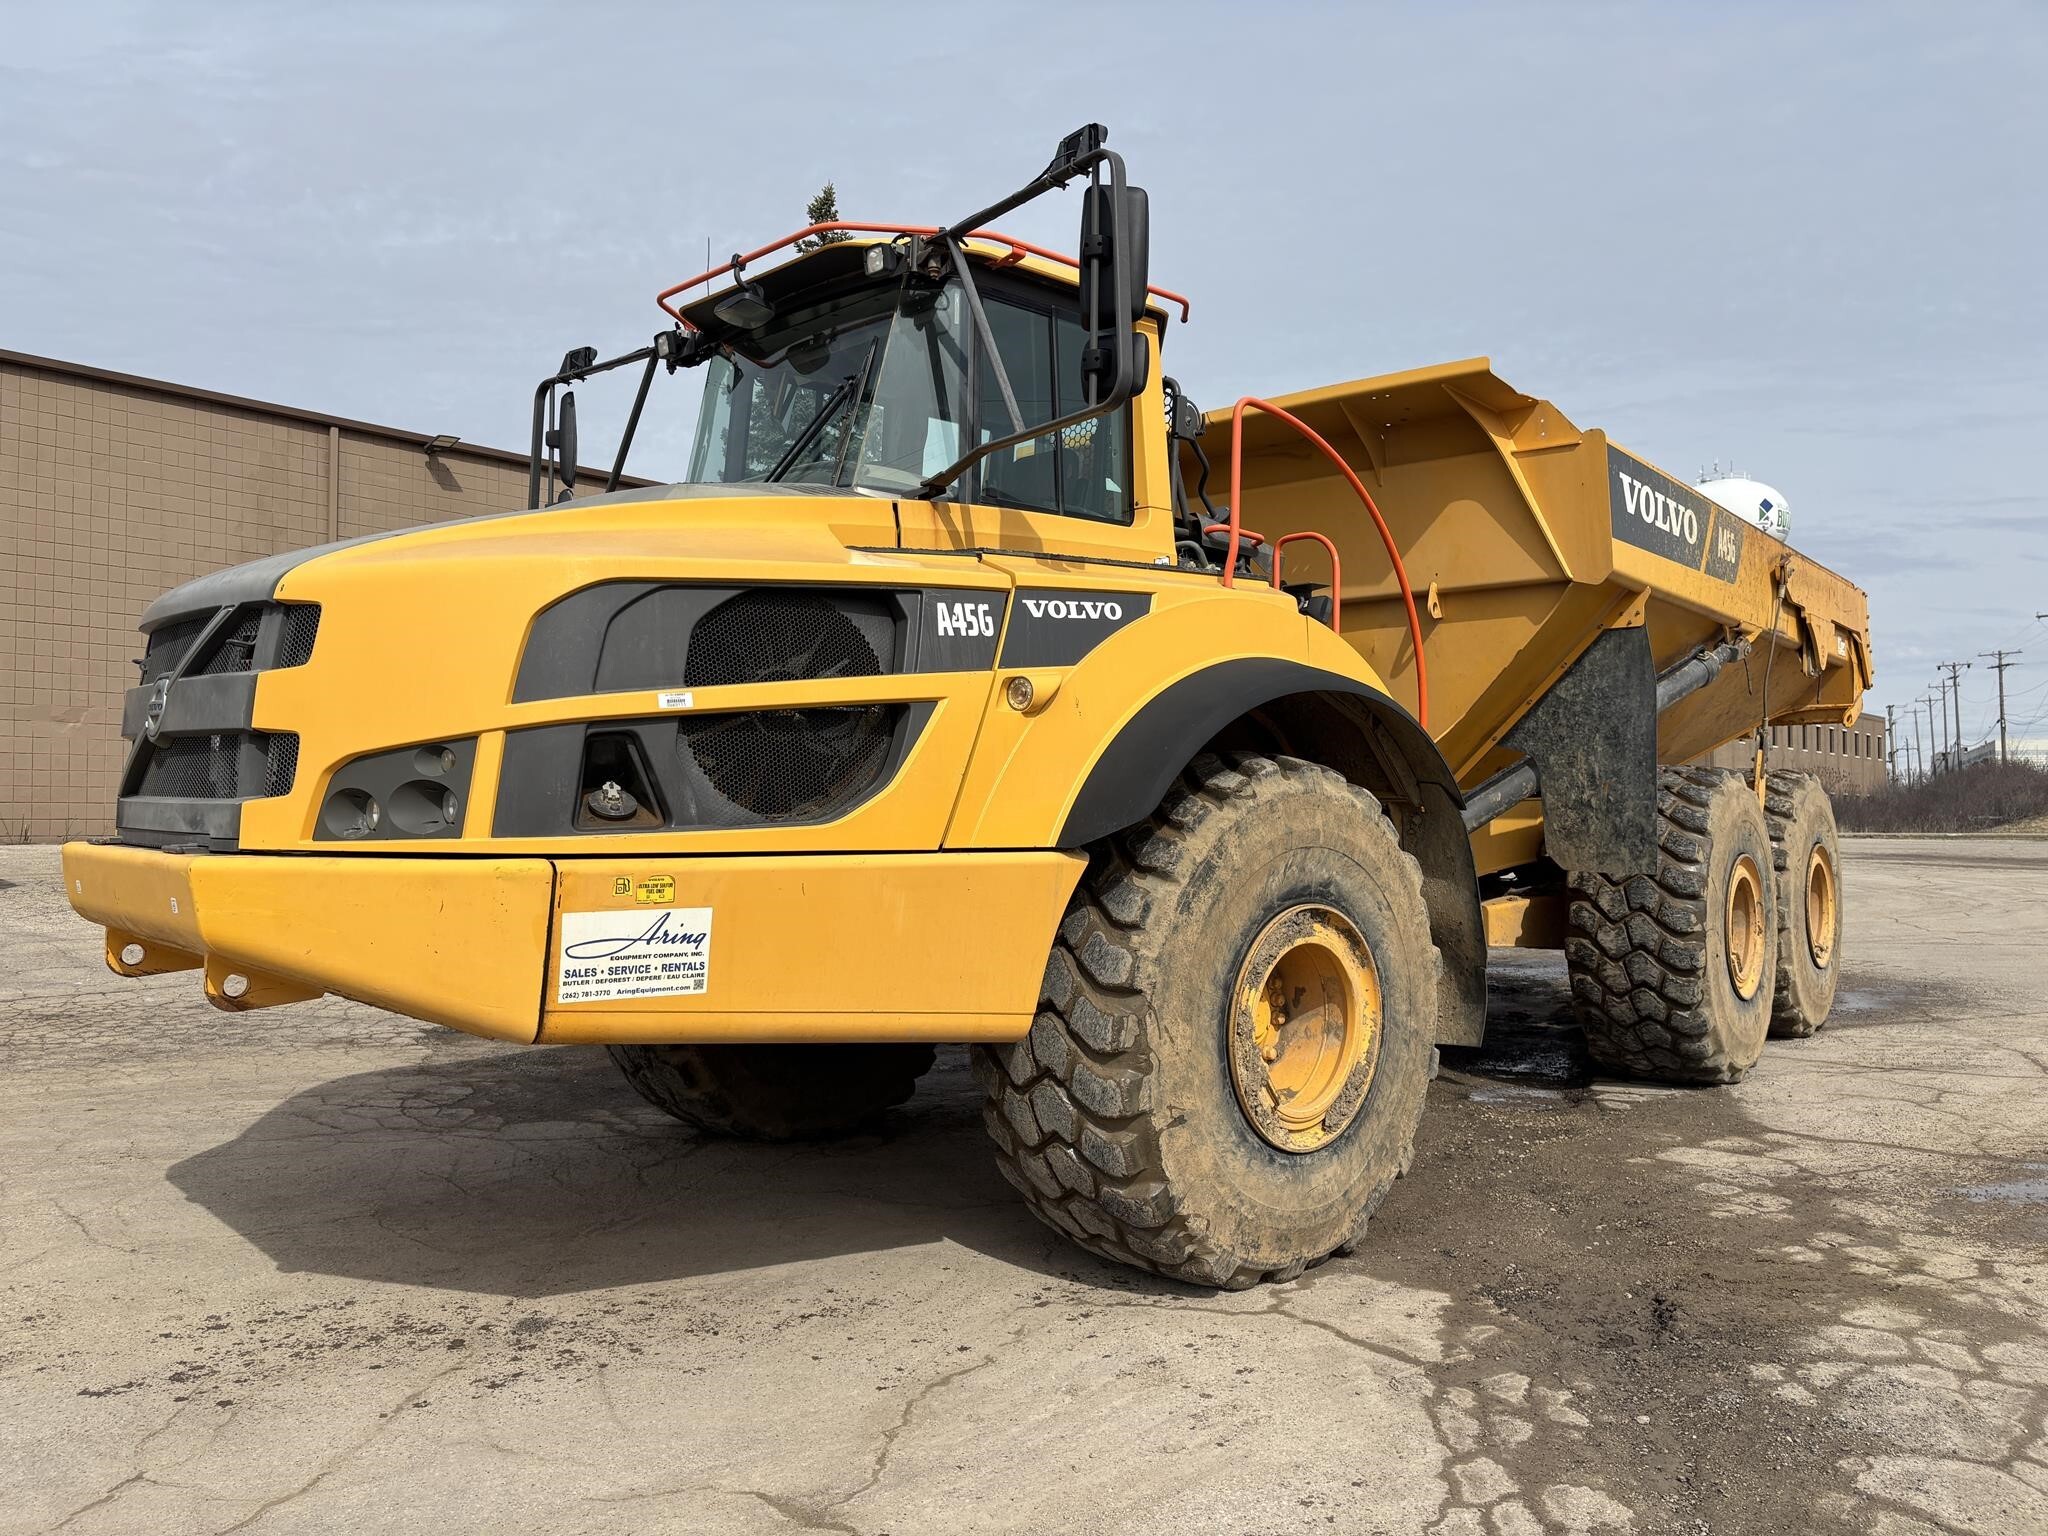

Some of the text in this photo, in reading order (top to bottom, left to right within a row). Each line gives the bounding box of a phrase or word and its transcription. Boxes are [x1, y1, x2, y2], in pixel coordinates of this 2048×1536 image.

[1619, 471, 1698, 545] VOLVO
[1022, 600, 1123, 620] VOLVO
[936, 602, 995, 637] A45G
[610, 953, 652, 961] EQUIPMENT
[564, 961, 705, 979] SALES SERVICE RENTALS
[595, 977, 631, 985] DEFOREST
[562, 991, 579, 1000] (262)
[581, 989, 611, 998] 781-3770
